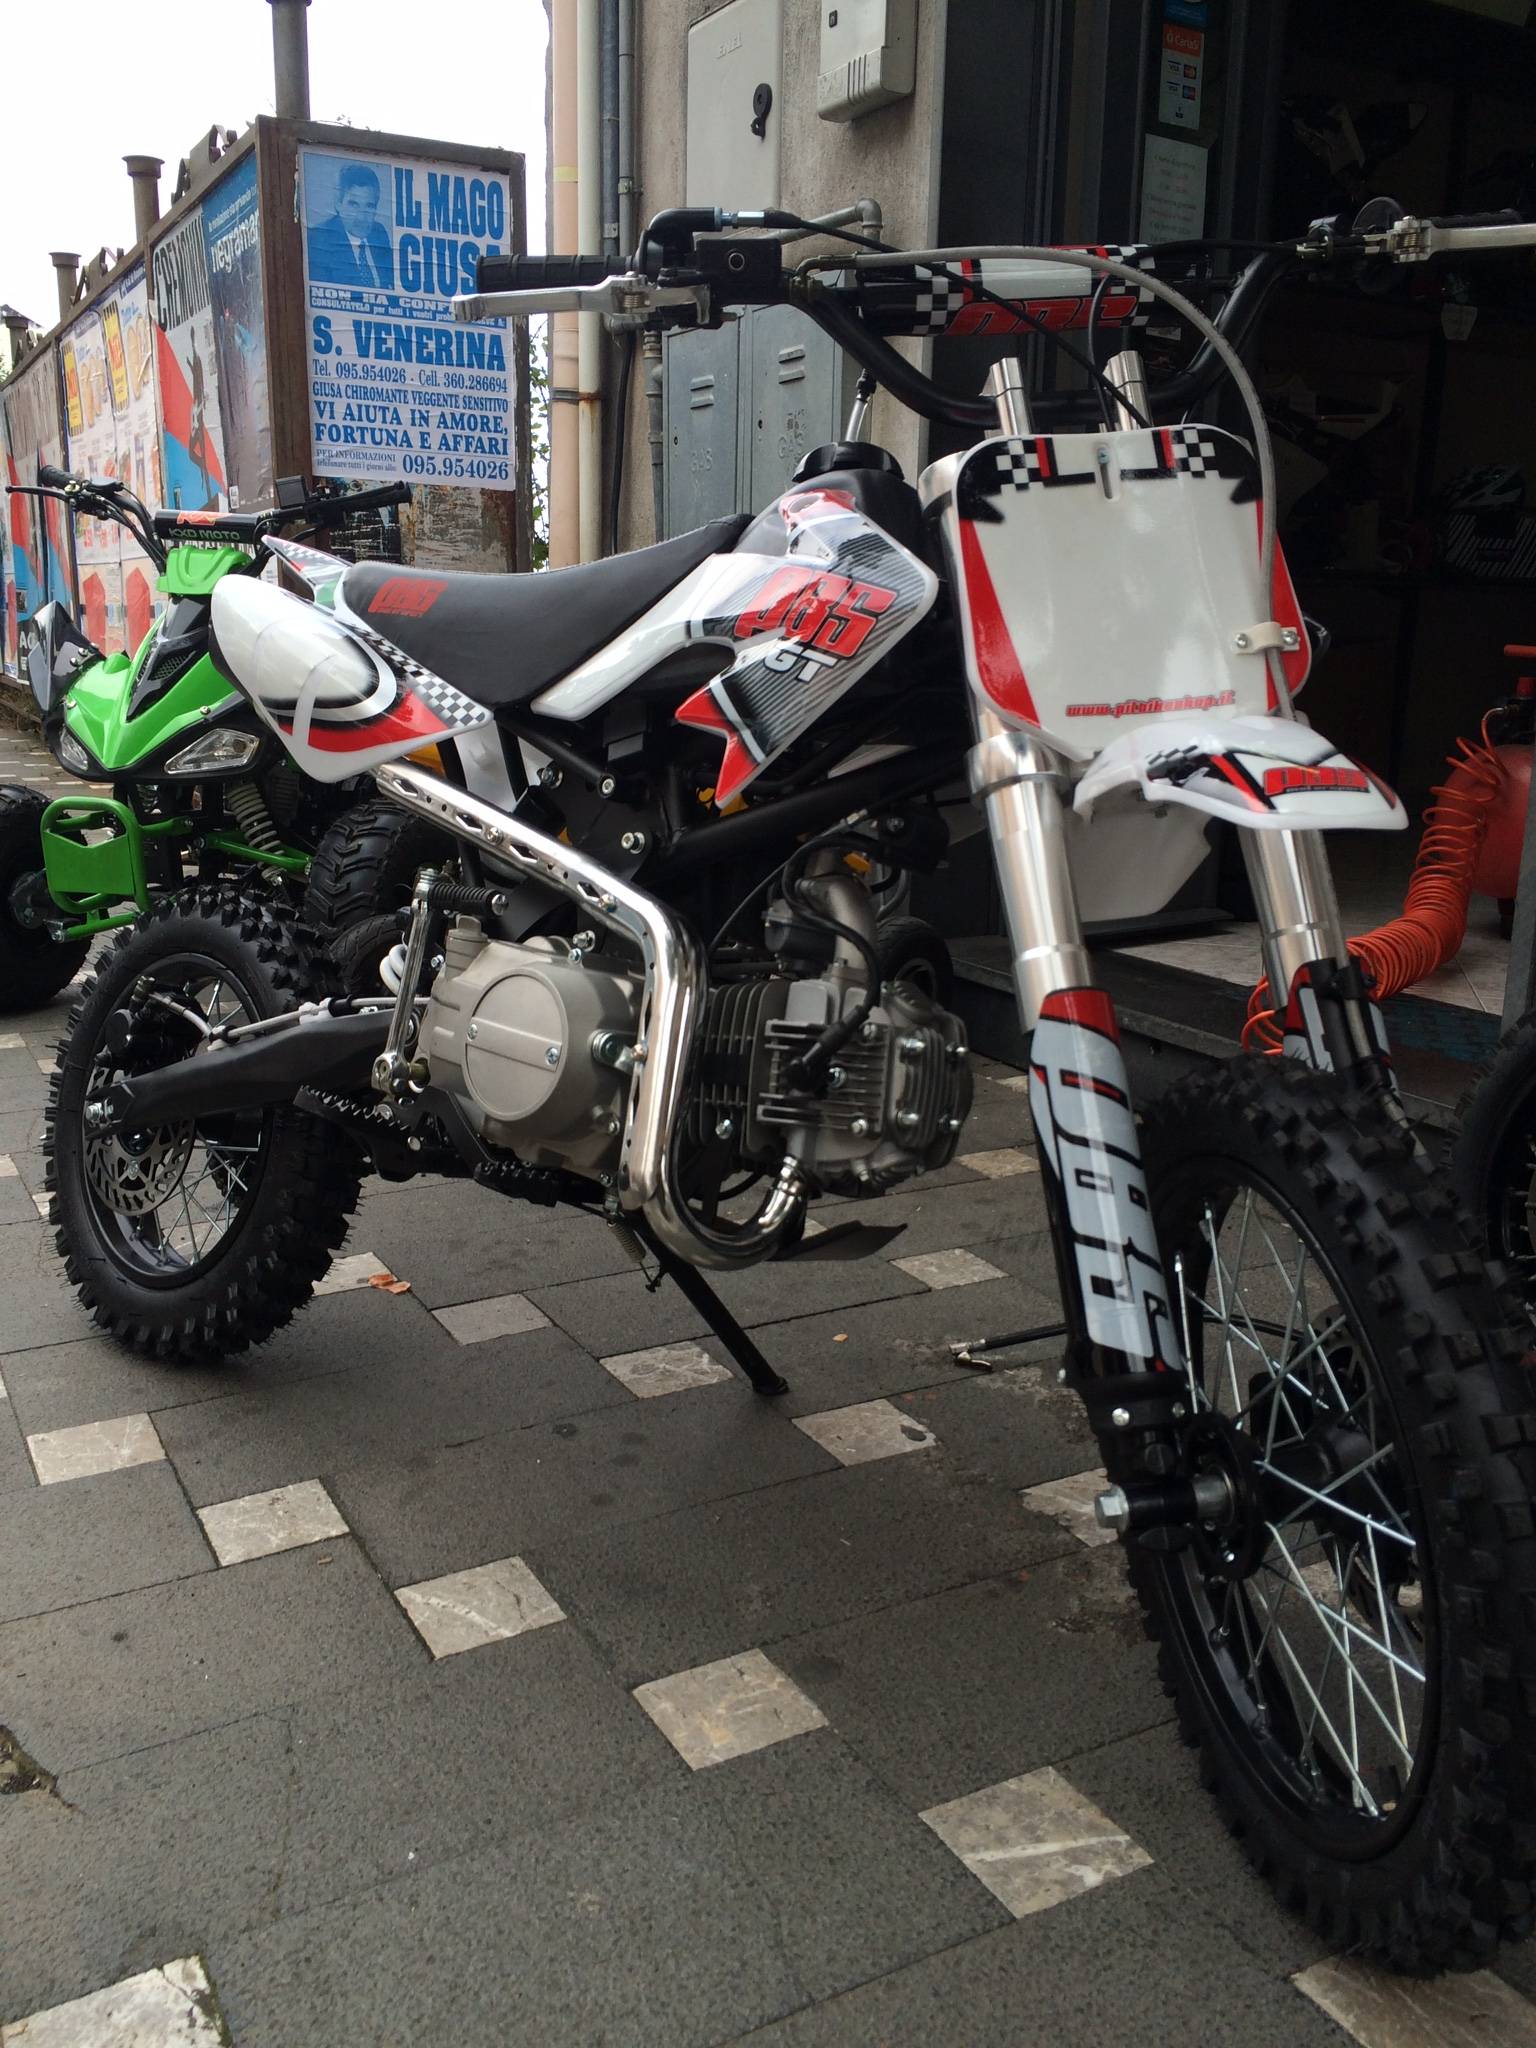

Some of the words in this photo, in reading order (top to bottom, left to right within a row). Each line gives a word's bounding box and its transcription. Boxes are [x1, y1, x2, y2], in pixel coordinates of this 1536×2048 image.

[394, 167, 422, 229] IL
[427, 172, 504, 240] MAGO
[399, 232, 501, 297] GIUS
[311, 286, 352, 302] NON
[362, 293, 389, 306] HA
[399, 296, 454, 312] CONF
[312, 297, 370, 312] CONSULTATELO
[313, 315, 343, 356] S.
[352, 319, 506, 372] VENERINA
[312, 359, 331, 377] Tel.
[335, 361, 406, 383] 095.954026
[418, 369, 440, 387] Cell.
[443, 372, 508, 394] 360.286694
[312, 381, 342, 398] GIUSA
[345, 384, 409, 405] CHIROMANTE
[411, 390, 460, 409] VEGGENTE
[462, 395, 509, 413] SENSITIVO
[313, 399, 336, 420] VI
[342, 403, 403, 426] AIUTA
[410, 408, 430, 428] IN
[436, 411, 508, 436] AMORE,
[314, 422, 414, 449] FORTUNA
[419, 431, 432, 450] E
[438, 433, 509, 456] AFFARI
[316, 448, 334, 458] PER
[335, 449, 397, 463] INFORMAZIONI
[402, 454, 509, 480] 095.954026
[168, 527, 196, 539] KXD
[199, 528, 241, 541] MOTO
[763, 643, 839, 684] GT
